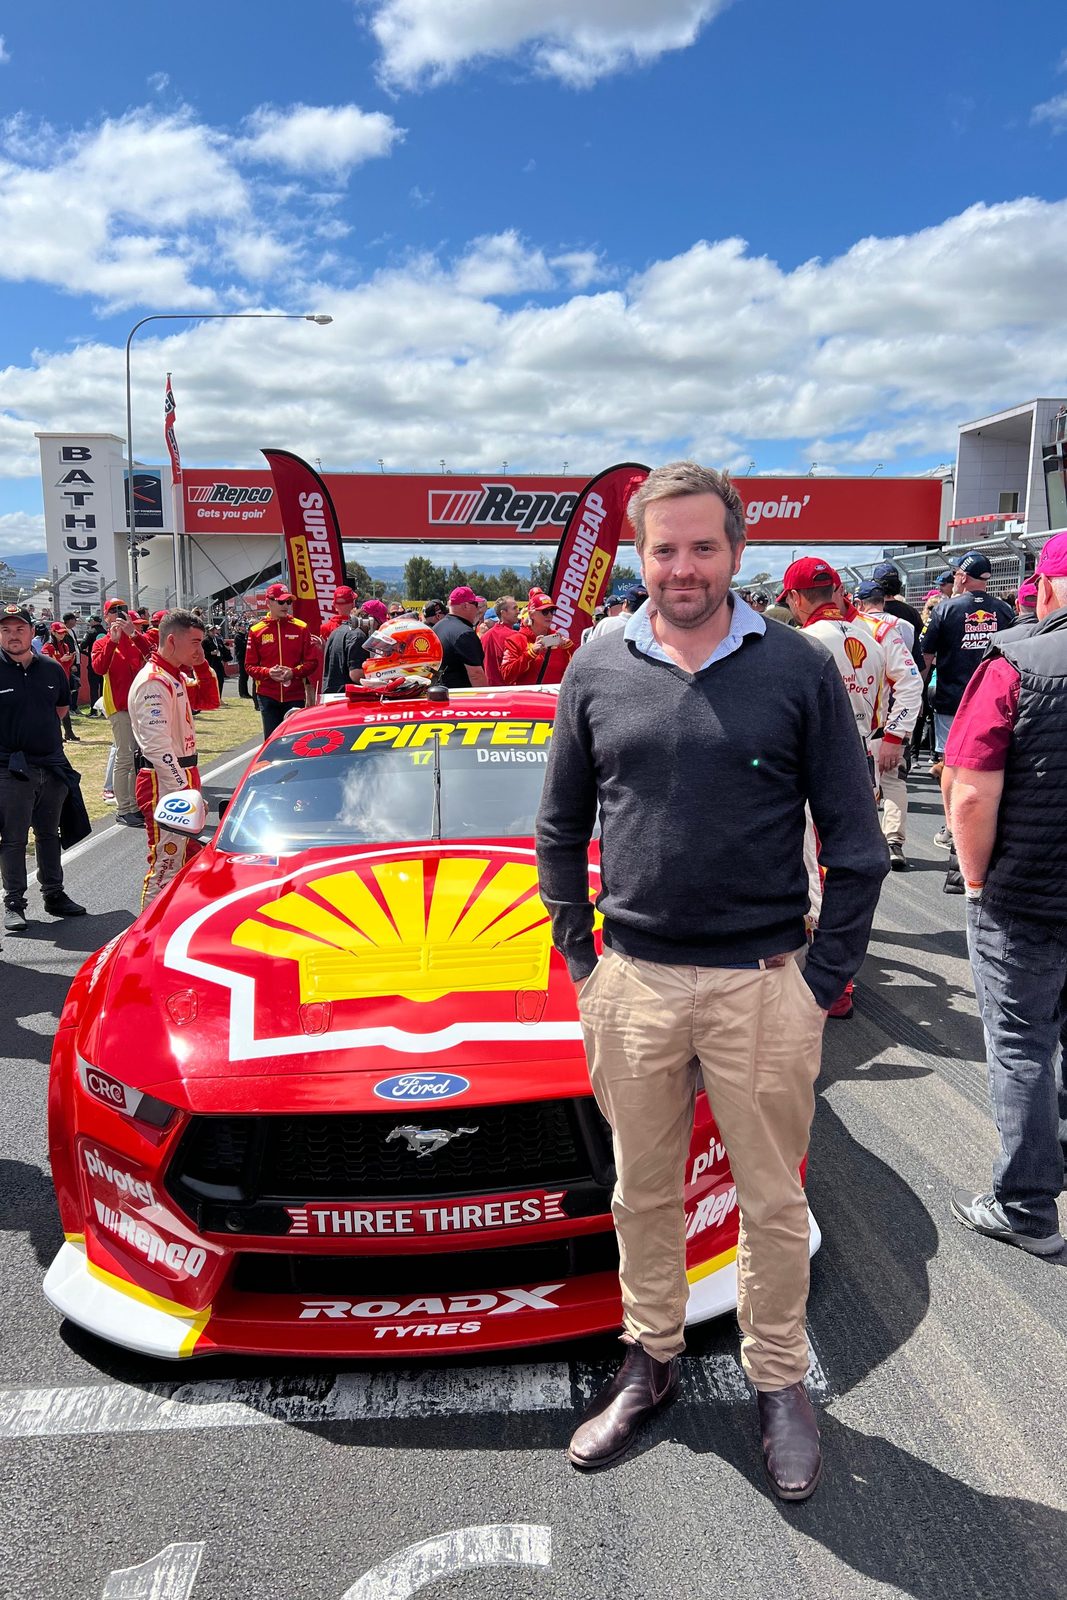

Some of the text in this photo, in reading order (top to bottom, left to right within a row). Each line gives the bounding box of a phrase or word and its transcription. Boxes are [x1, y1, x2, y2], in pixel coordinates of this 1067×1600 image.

[207, 483, 273, 506] Repco
[196, 508, 220, 518] Gets
[222, 511, 240, 520] you
[471, 484, 581, 532] Repc
[294, 542, 310, 593] AUTO
[584, 556, 604, 607] AUTO
[363, 711, 414, 722] Shell
[409, 748, 548, 765] 17 Davison
[169, 764, 186, 786] PIRTEK
[157, 811, 190, 825] Doric
[88, 1073, 124, 1104] CRC
[391, 1075, 451, 1097] Ford
[312, 1198, 542, 1233] THREE THREES
[118, 1209, 207, 1278] Repco
[298, 1283, 566, 1319] ROADX
[373, 1321, 482, 1339] TYRES
